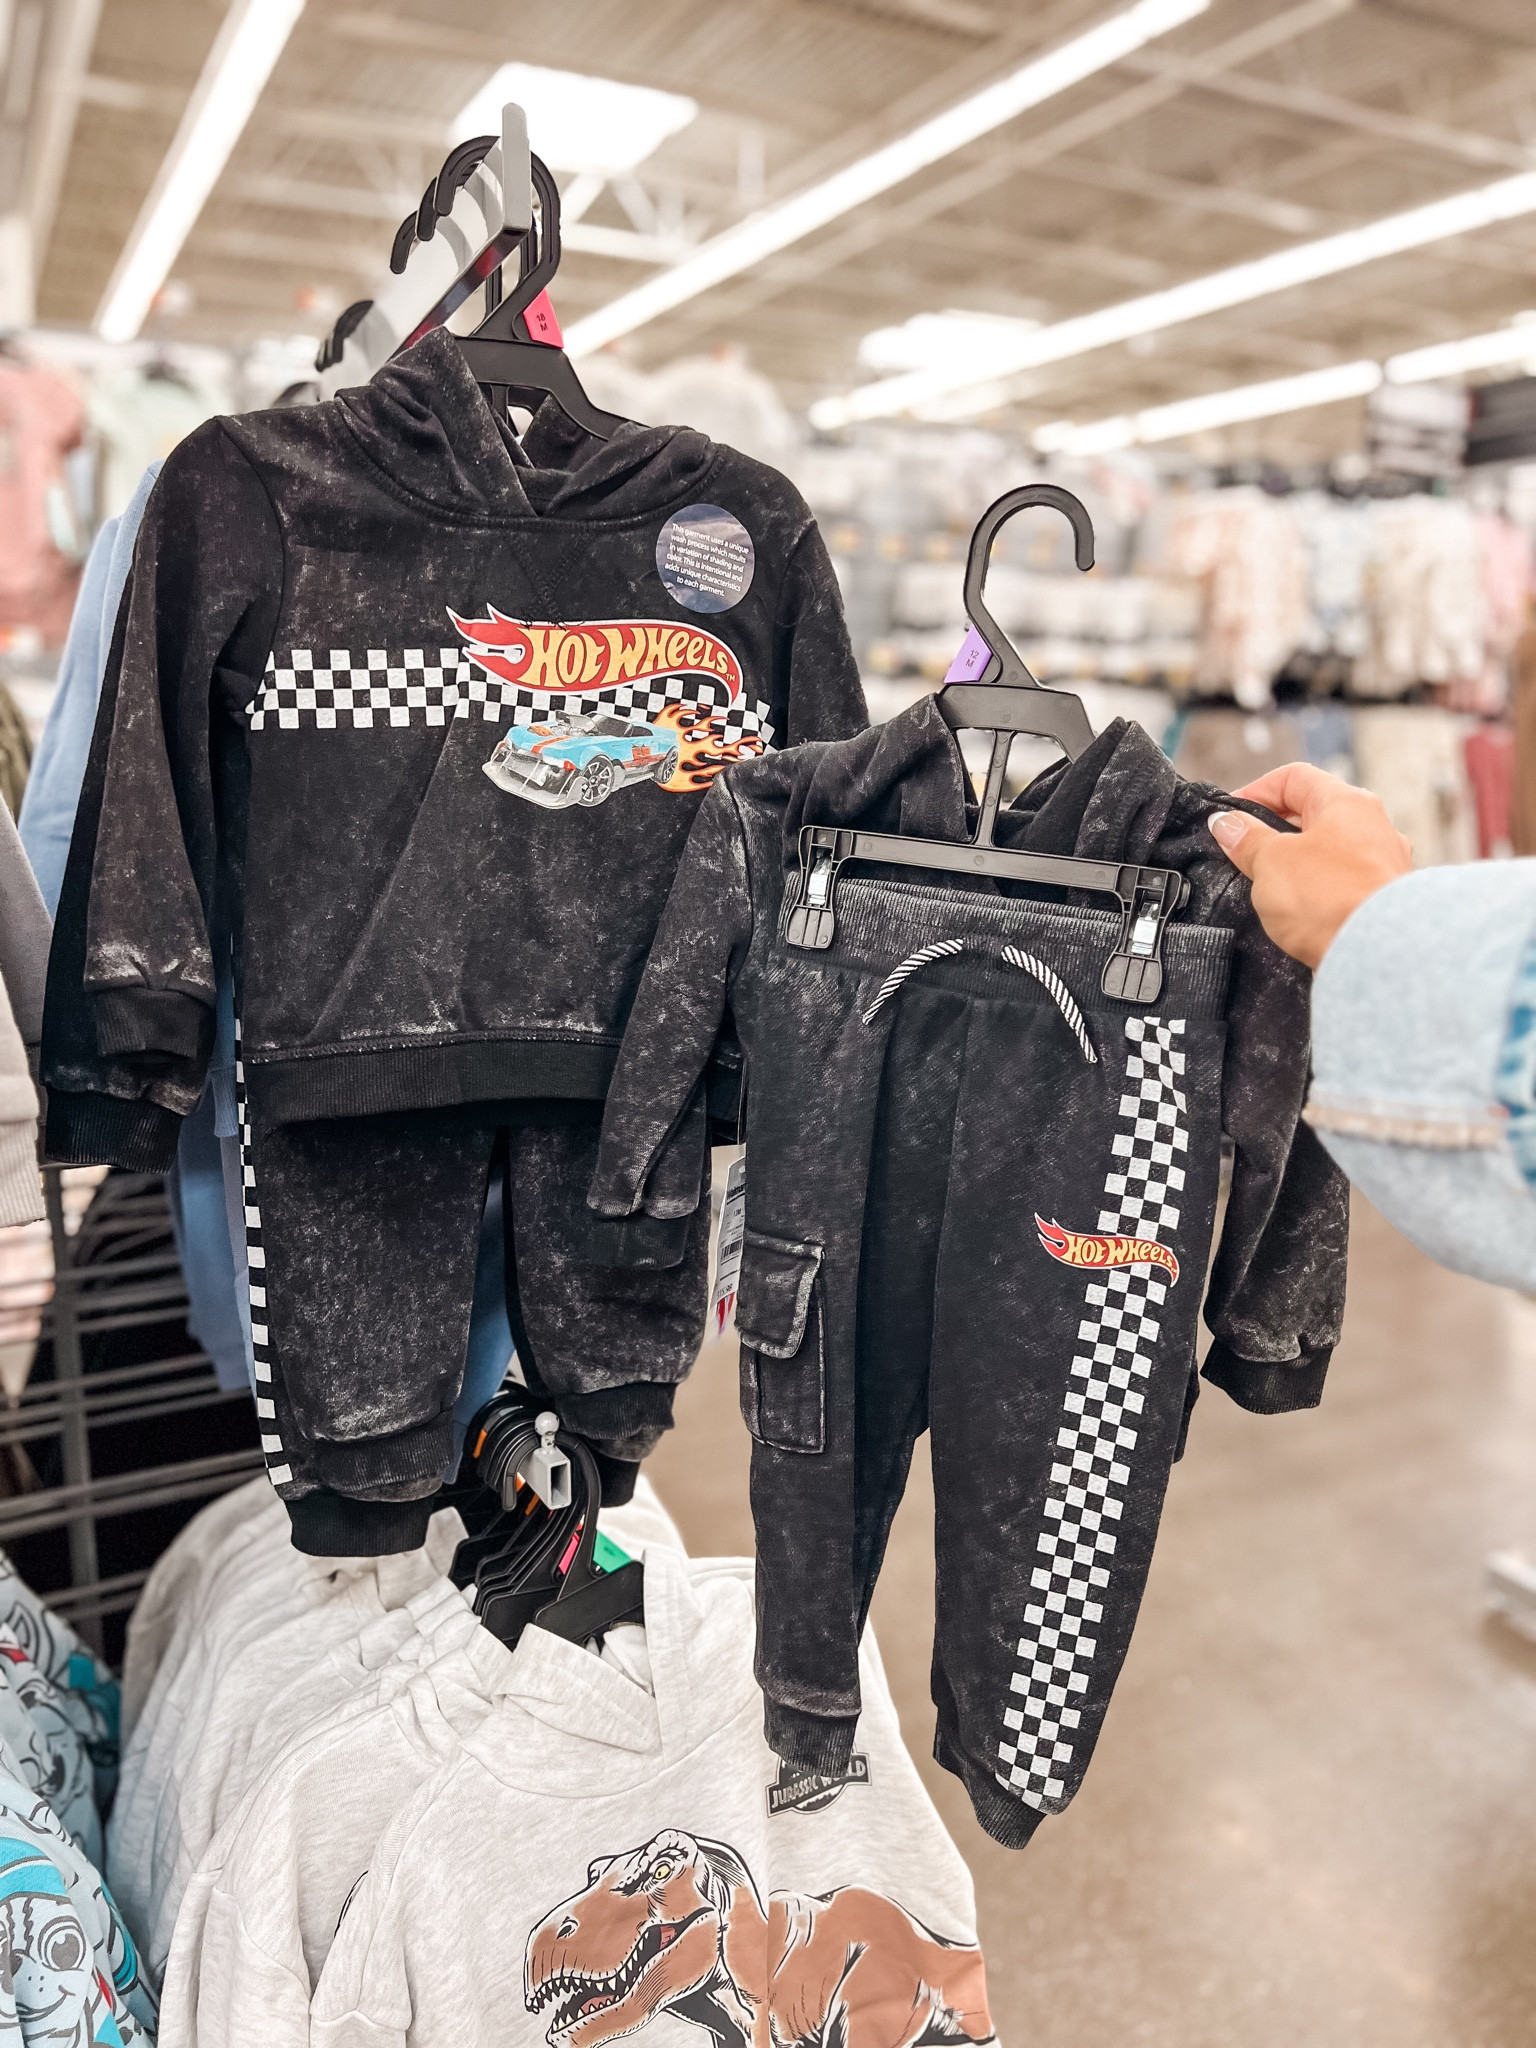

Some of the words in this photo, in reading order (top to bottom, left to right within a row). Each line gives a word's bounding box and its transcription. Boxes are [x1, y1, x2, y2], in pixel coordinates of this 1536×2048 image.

[536, 313, 545, 322] 18
[540, 323, 549, 332] M
[671, 533, 687, 544] wash
[687, 539, 709, 551] process
[710, 545, 728, 558] which
[728, 552, 746, 564] results
[672, 523, 684, 533] This
[685, 529, 710, 542] garment
[710, 536, 724, 546] uses
[729, 542, 749, 555] unique
[669, 542, 676, 551] in
[676, 545, 702, 559] variation
[702, 553, 710, 561] of
[710, 555, 732, 570] shading
[732, 563, 744, 573] and
[683, 556, 695, 567] This
[700, 561, 732, 579] intentional
[731, 573, 743, 583] and
[664, 562, 680, 573] adds
[680, 567, 702, 579] unique
[701, 573, 741, 592] characteristics
[676, 576, 684, 584] to
[684, 578, 699, 589] each
[699, 583, 725, 597] garment.
[965, 659, 974, 668] M
[970, 650, 979, 660] 12
[771, 1774, 819, 1809] JURASSIC
